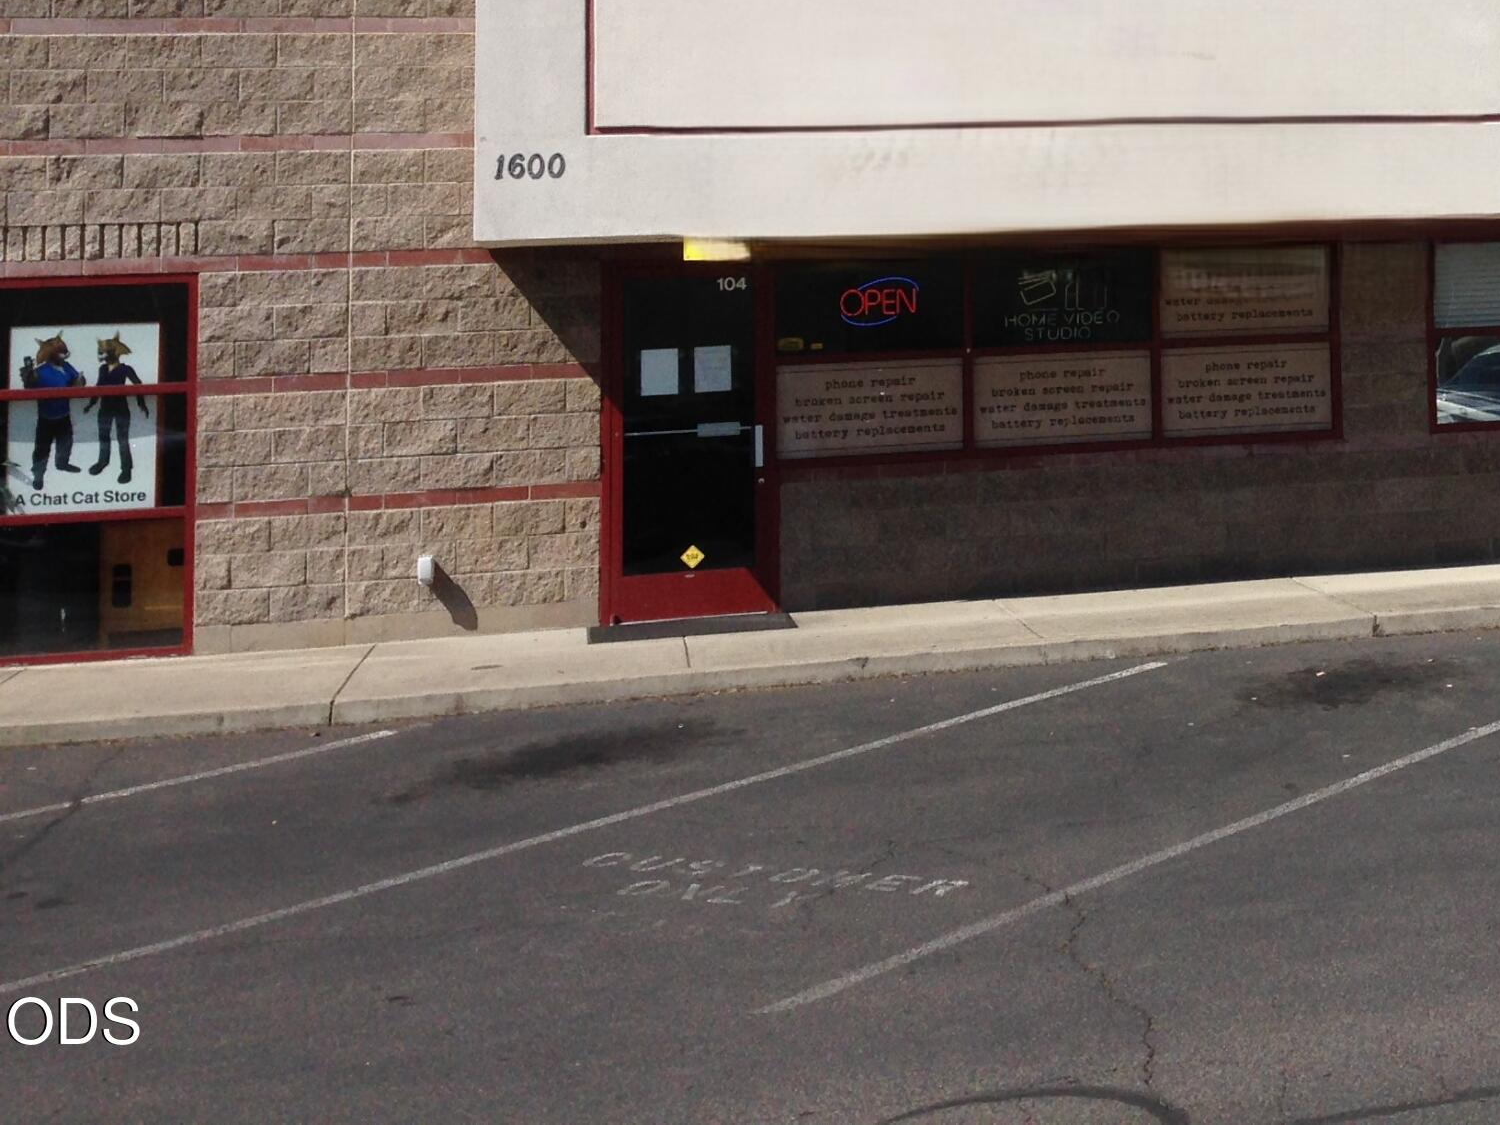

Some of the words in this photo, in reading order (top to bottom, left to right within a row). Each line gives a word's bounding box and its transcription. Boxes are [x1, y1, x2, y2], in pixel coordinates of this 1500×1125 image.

[494, 152, 566, 180] 1600
[717, 277, 747, 291] 104
[840, 288, 917, 316] OPEN
[1004, 313, 1057, 327] HOME
[1064, 310, 1121, 325] VIDEO
[1231, 308, 1313, 321] replacements
[1024, 326, 1091, 341] STUDIO
[1205, 361, 1240, 373] phone
[1247, 359, 1287, 371] repair
[825, 376, 864, 391] phone
[870, 375, 916, 389] repair
[1019, 370, 1057, 382] phone
[1063, 368, 1106, 379] repair
[1178, 377, 1221, 389] broken
[1227, 376, 1267, 387] screen
[1273, 373, 1315, 385] repair
[991, 387, 1036, 397] broken
[1042, 385, 1084, 395] screen
[1091, 382, 1134, 394] repair
[1167, 394, 1204, 405] water
[1208, 392, 1252, 404] damage
[1258, 389, 1326, 401] treatments
[795, 396, 842, 407] broken
[849, 394, 893, 405] screen
[900, 391, 945, 403] repair
[979, 403, 1017, 414] water
[1023, 401, 1068, 413] damage
[1075, 397, 1146, 409] treatments
[783, 412, 822, 424] water
[828, 411, 876, 423] damage
[882, 406, 958, 420] treatments
[1178, 409, 1228, 420] battery
[1234, 405, 1316, 418] replacements
[991, 418, 1042, 430] battery
[1049, 414, 1135, 427] replacements
[795, 427, 848, 440] battery
[856, 423, 945, 438] replacements
[15, 494, 26, 505] A
[30, 493, 68, 506] Chat
[72, 491, 100, 504] Cat
[103, 490, 147, 503] Store
[582, 851, 970, 897] CUSTOMER
